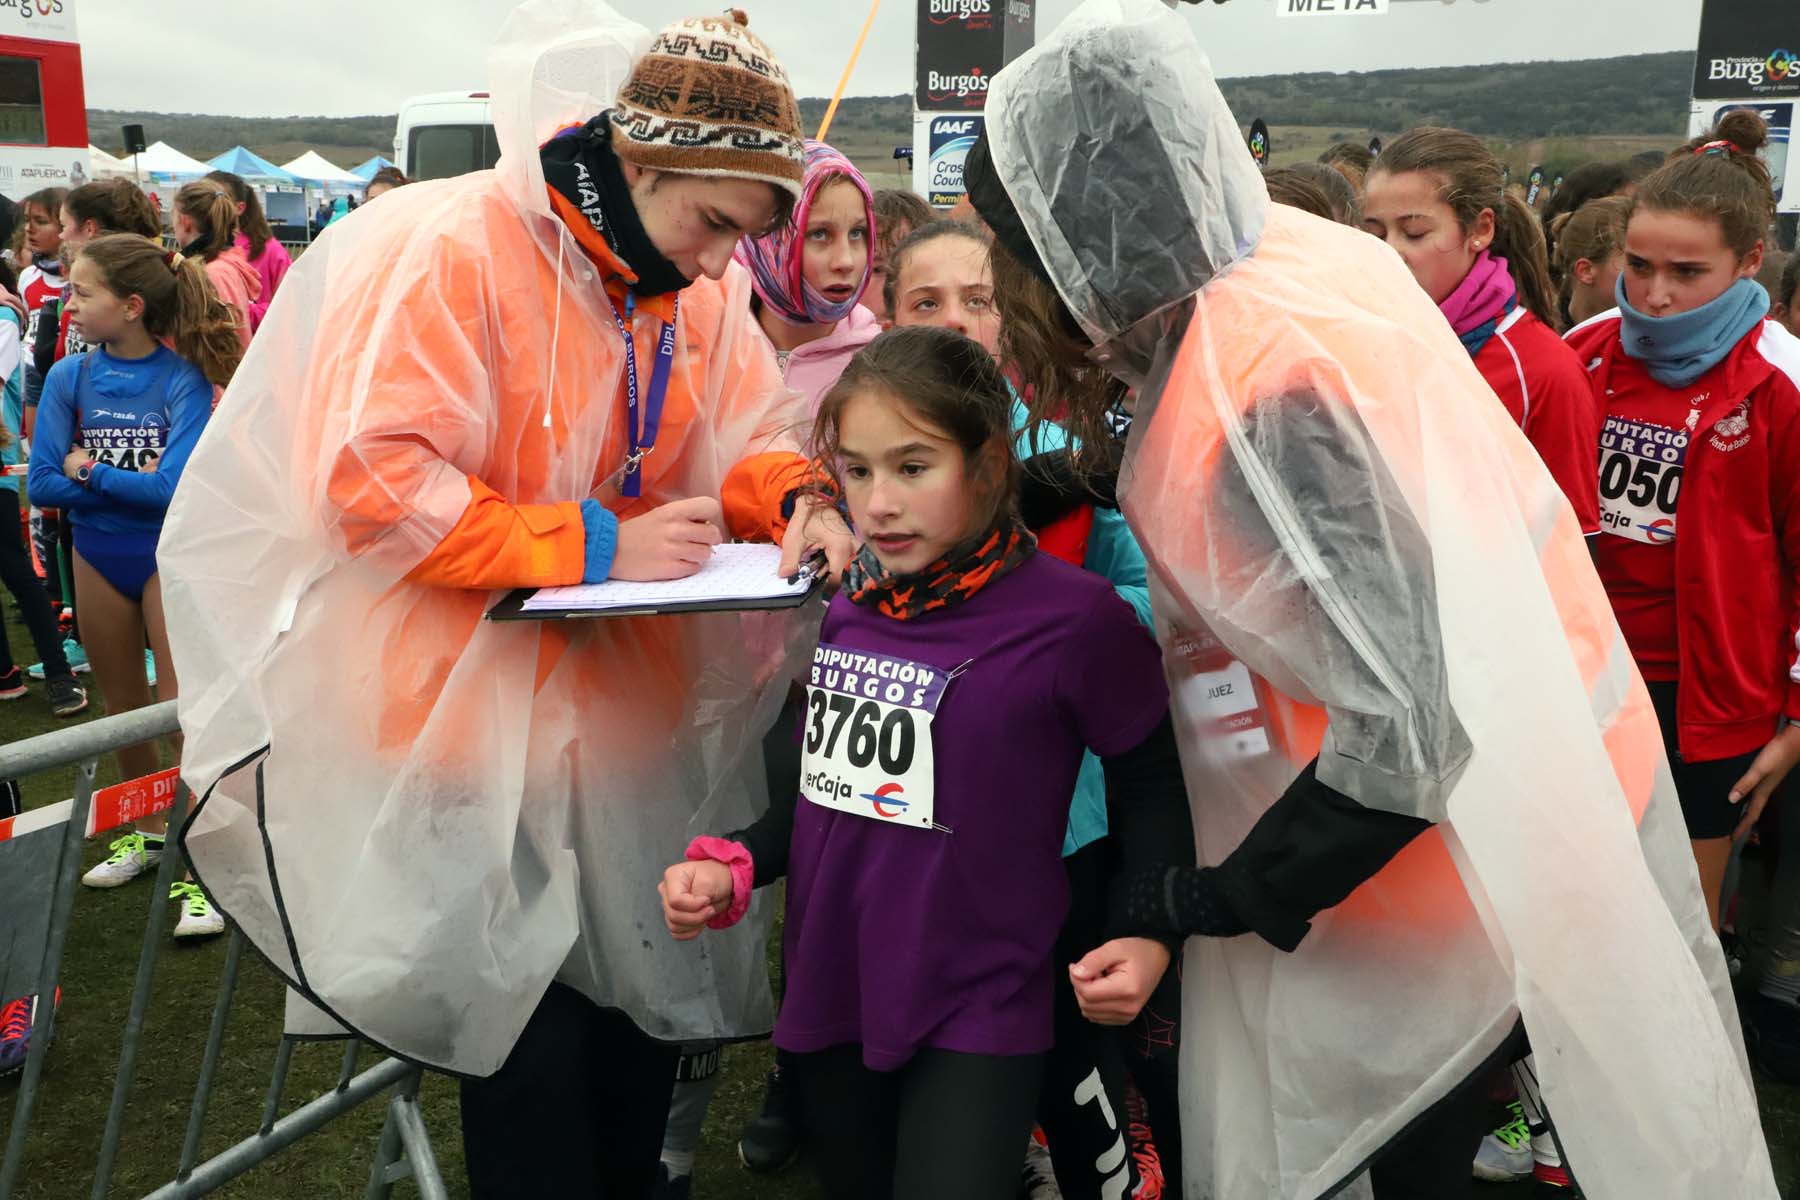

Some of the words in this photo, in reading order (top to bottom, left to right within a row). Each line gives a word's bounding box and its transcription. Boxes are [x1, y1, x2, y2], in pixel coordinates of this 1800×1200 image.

[930, 0, 991, 19] Burgos
[928, 70, 988, 97] Burgos
[1709, 48, 1800, 85] Burgos
[933, 121, 975, 134] IAAF
[573, 162, 604, 231] ATAP
[626, 342, 637, 409] BURGOS
[84, 437, 160, 448] BURGOS
[1599, 448, 1684, 515] 050
[811, 665, 927, 708] BURGOS
[814, 647, 935, 688] DIPUTACIÓN
[1208, 683, 1234, 700] JUEZ
[806, 688, 916, 776] 3760
